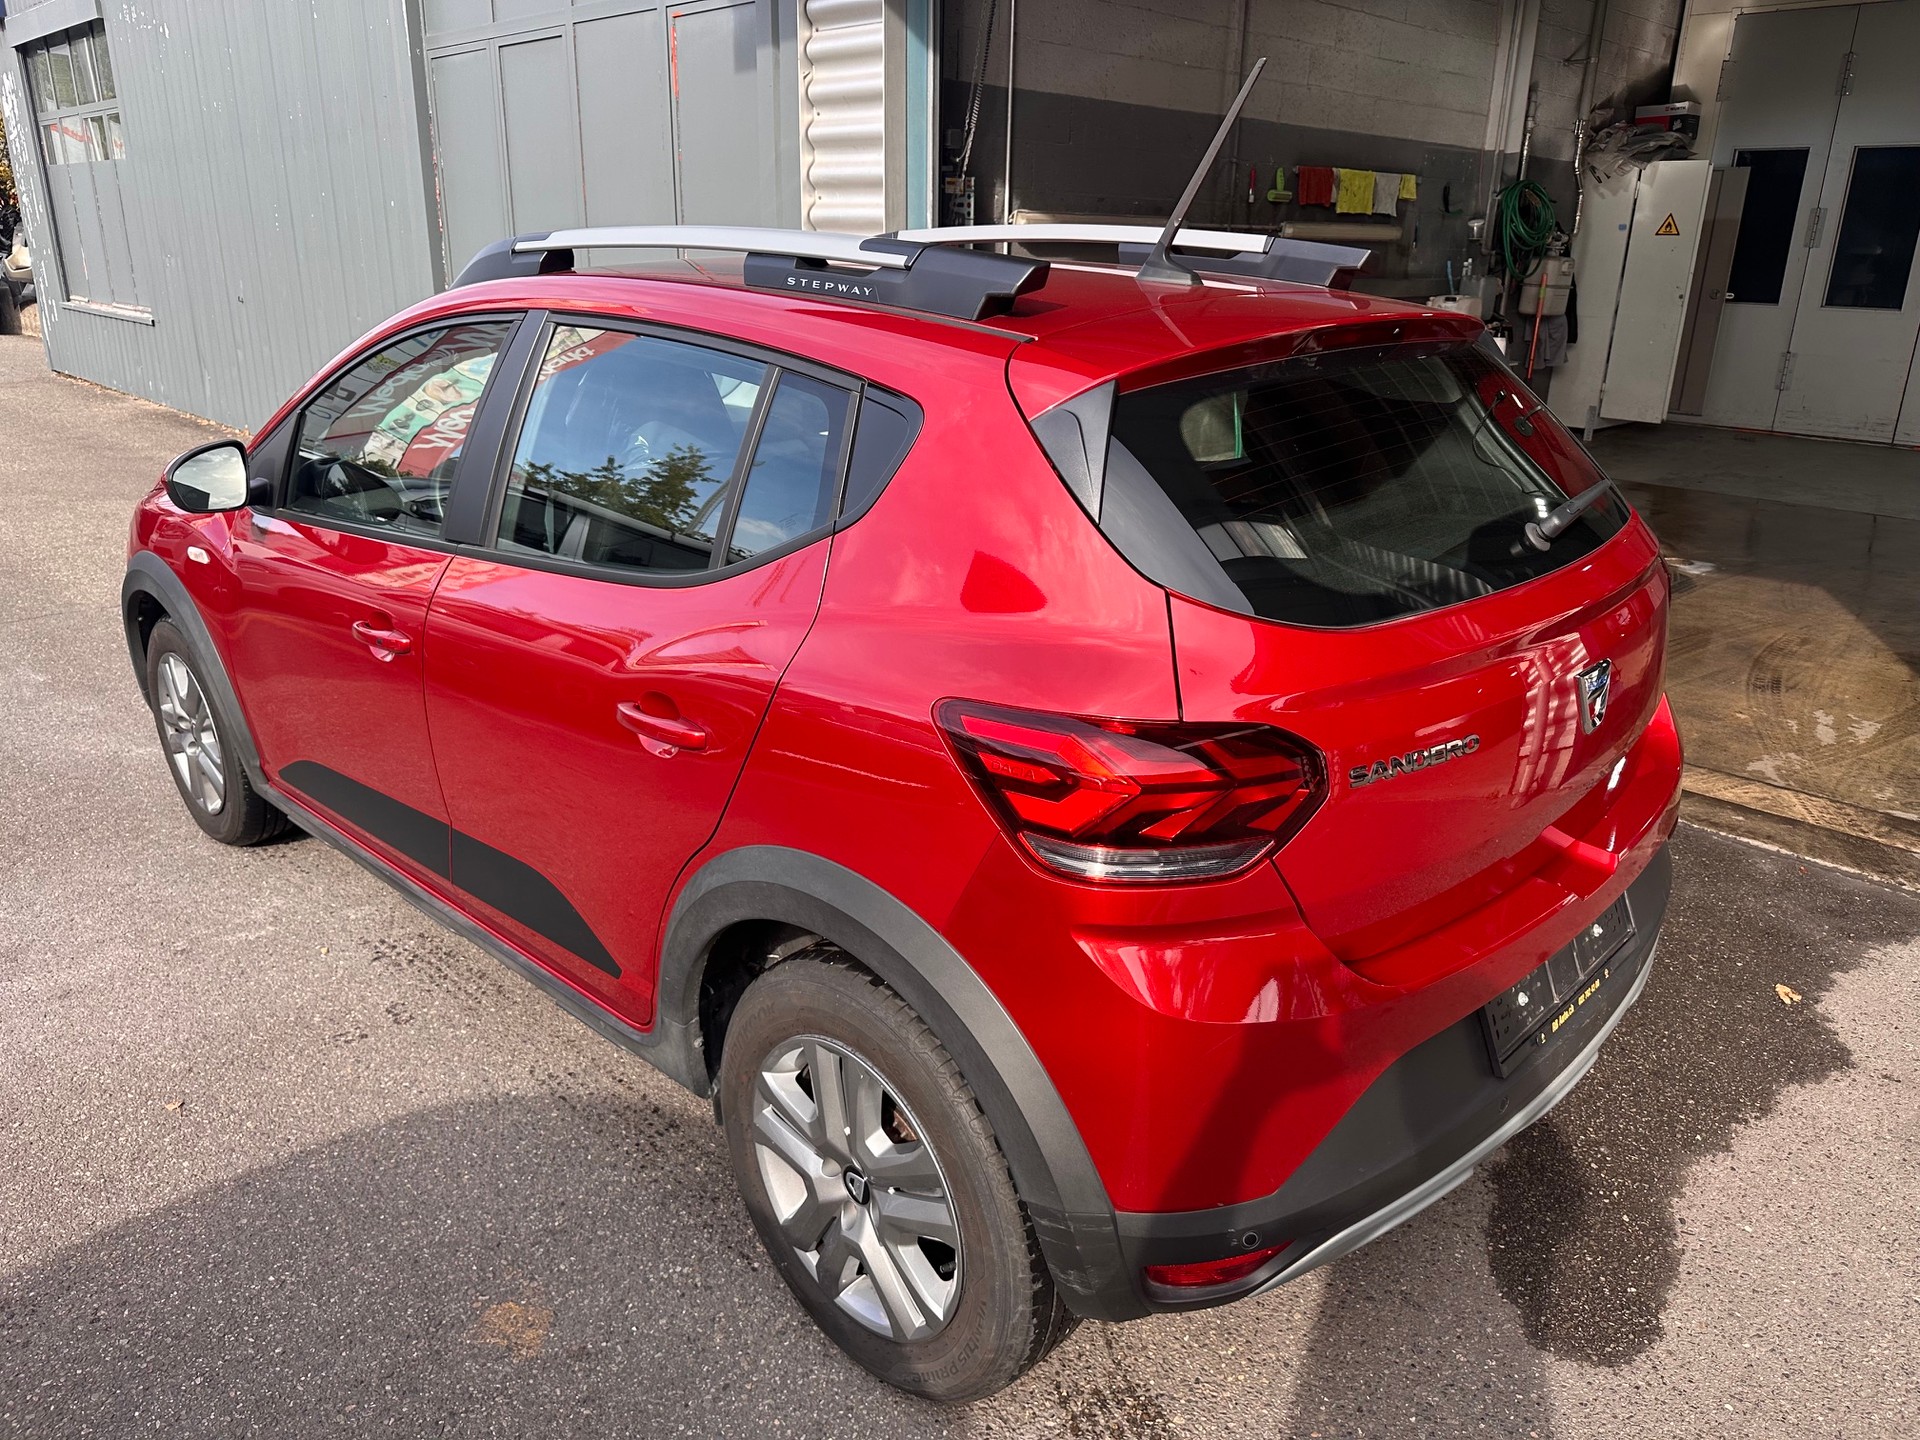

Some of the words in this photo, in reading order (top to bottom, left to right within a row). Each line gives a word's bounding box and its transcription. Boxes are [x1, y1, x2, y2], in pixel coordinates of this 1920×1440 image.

[786, 276, 873, 297] STEPWAY
[992, 760, 1036, 780] DACIA
[1348, 733, 1481, 789] SANDERO
